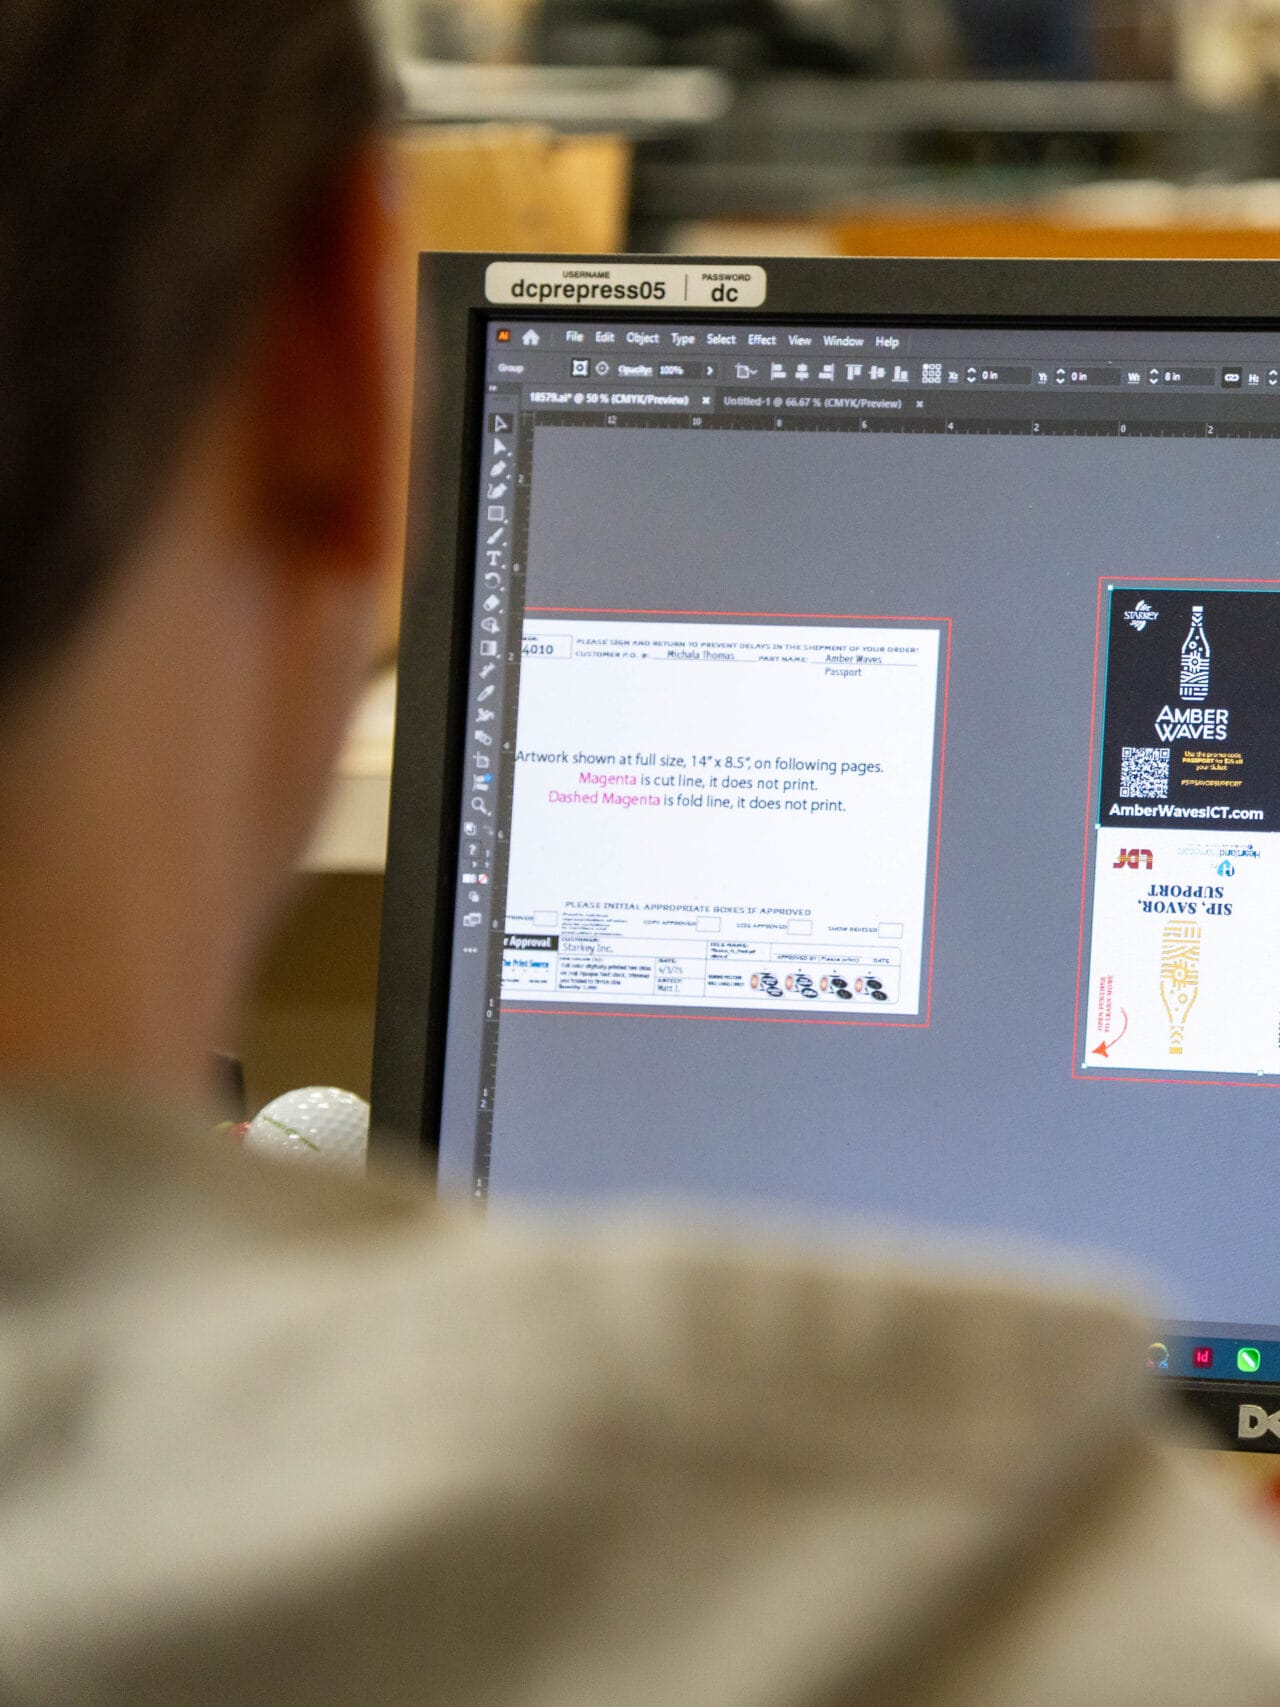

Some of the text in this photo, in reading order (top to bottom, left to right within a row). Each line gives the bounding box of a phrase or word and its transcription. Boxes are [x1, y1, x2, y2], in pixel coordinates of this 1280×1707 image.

[562, 270, 610, 279] USERNAME
[702, 274, 751, 282] PASSWORD
[511, 279, 666, 302] dcprepress05
[711, 283, 739, 302] dc
[566, 331, 899, 350] File Edit Object Type Select Effect View Window Help
[667, 650, 735, 660] Michala Thomas
[825, 654, 882, 664] Amber Waves
[825, 667, 862, 679] Passport
[1156, 704, 1229, 725] AMBER
[1154, 722, 1228, 742] WAVES
[515, 750, 568, 764] Artwork
[572, 751, 616, 765] shown
[619, 754, 632, 766] at
[635, 752, 656, 766] full
[660, 755, 687, 769] size,
[714, 759, 721, 768] x
[754, 759, 771, 769] on
[775, 756, 837, 774] following
[841, 761, 884, 776] pages.
[579, 771, 818, 793] Magenta is cut line, it does not print.
[548, 790, 846, 814] Dashed Magenta is fold line, it does not print.
[1108, 802, 1264, 820] AmberWavesICT.com
[1147, 884, 1224, 899] SUPPORT
[565, 901, 601, 909] PLEASE
[603, 902, 641, 910] INITIAL
[643, 904, 710, 913] APPROPRIATE
[713, 906, 745, 914] BOXES
[760, 908, 812, 916] APPROVED
[1137, 900, 1233, 916] SIP, SAVOR,
[563, 943, 595, 955] Starkey
